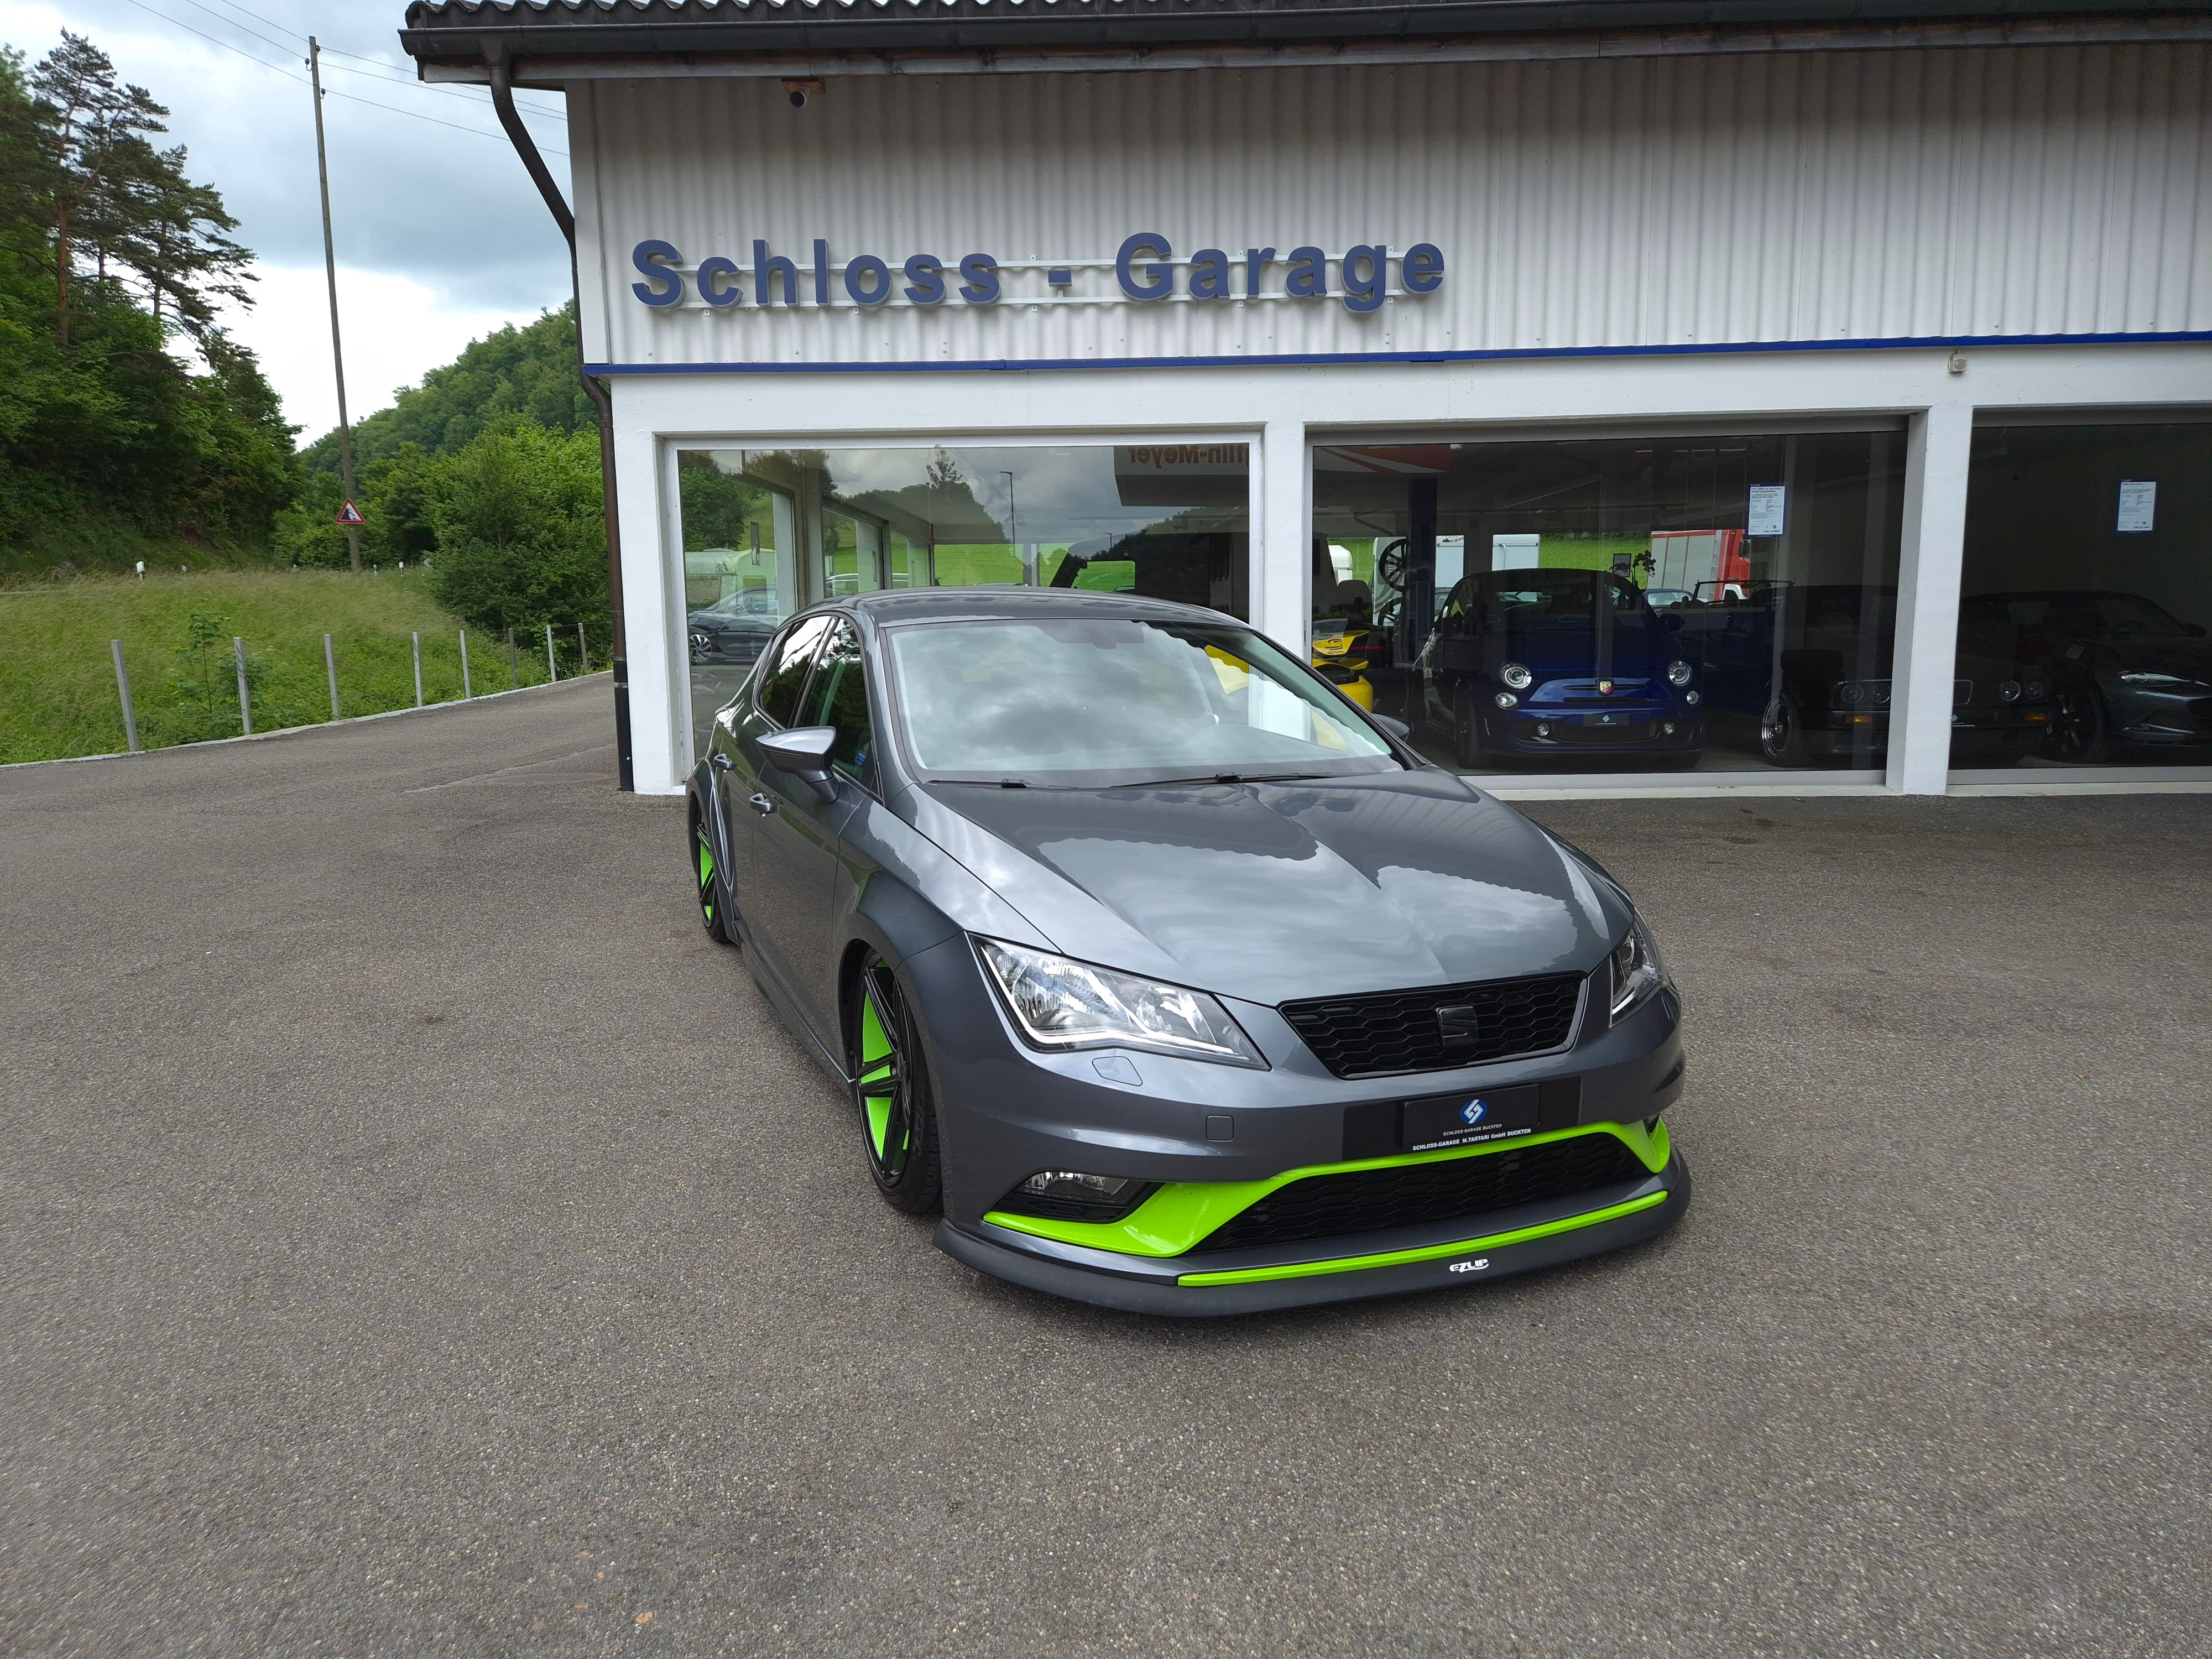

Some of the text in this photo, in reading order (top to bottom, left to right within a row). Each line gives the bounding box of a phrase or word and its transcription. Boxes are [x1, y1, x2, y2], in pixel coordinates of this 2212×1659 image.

[632, 238, 1001, 308] Schloss
[1115, 232, 1445, 314] Garage
[1412, 1139, 1460, 1151] SCHLOSS-GARAGE
[1507, 1128, 1531, 1136] BUCKTEN
[1443, 1126, 1481, 1136] SCHLOSS-GARAGE
